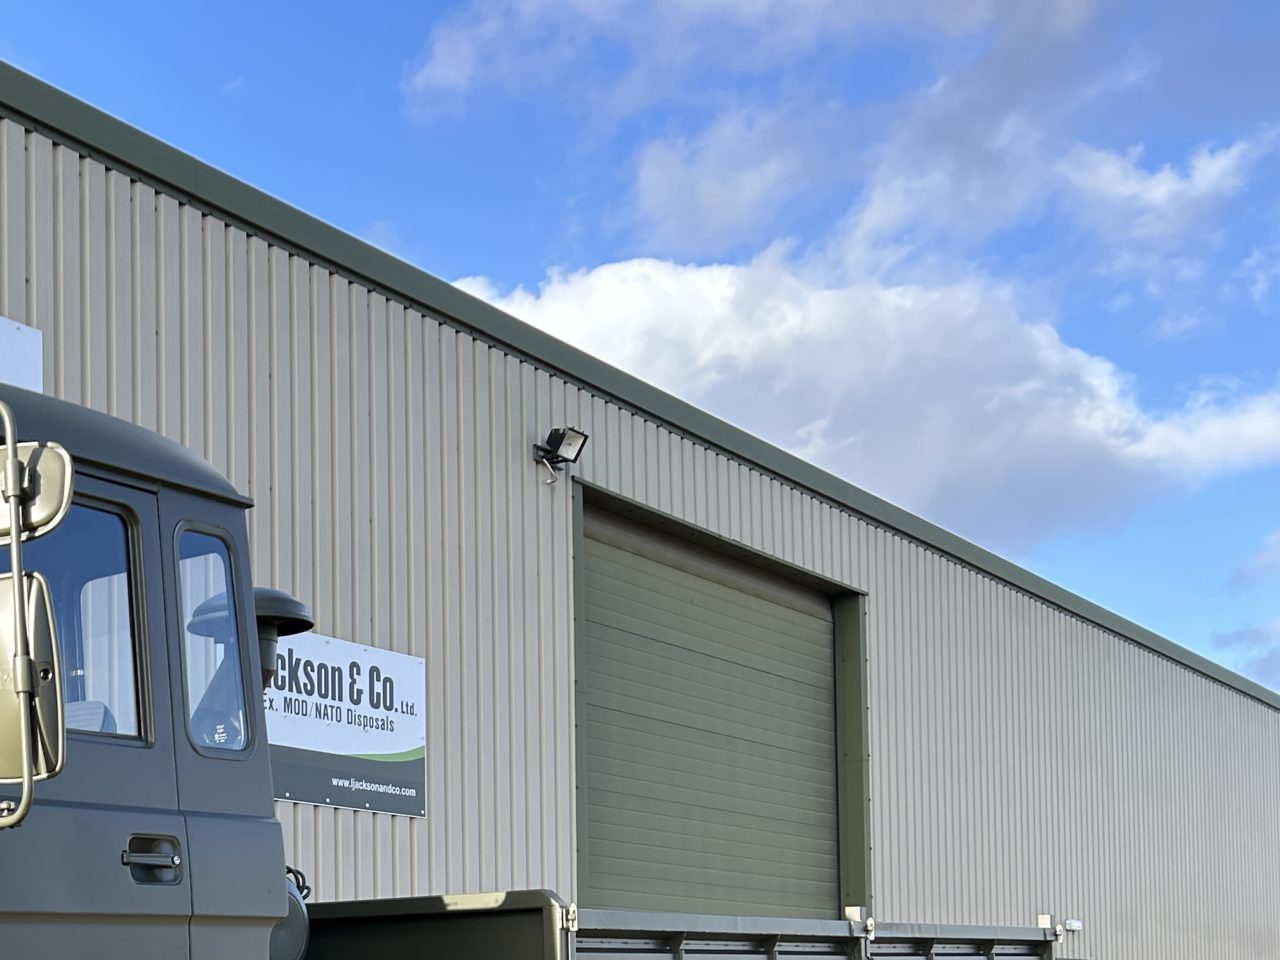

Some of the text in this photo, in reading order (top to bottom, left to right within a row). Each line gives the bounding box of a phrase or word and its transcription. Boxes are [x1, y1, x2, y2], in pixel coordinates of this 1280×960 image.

[265, 647, 418, 717] ckson & Co. Ltd.
[283, 696, 342, 723] MOD/NATO
[346, 708, 395, 733] Disposals
